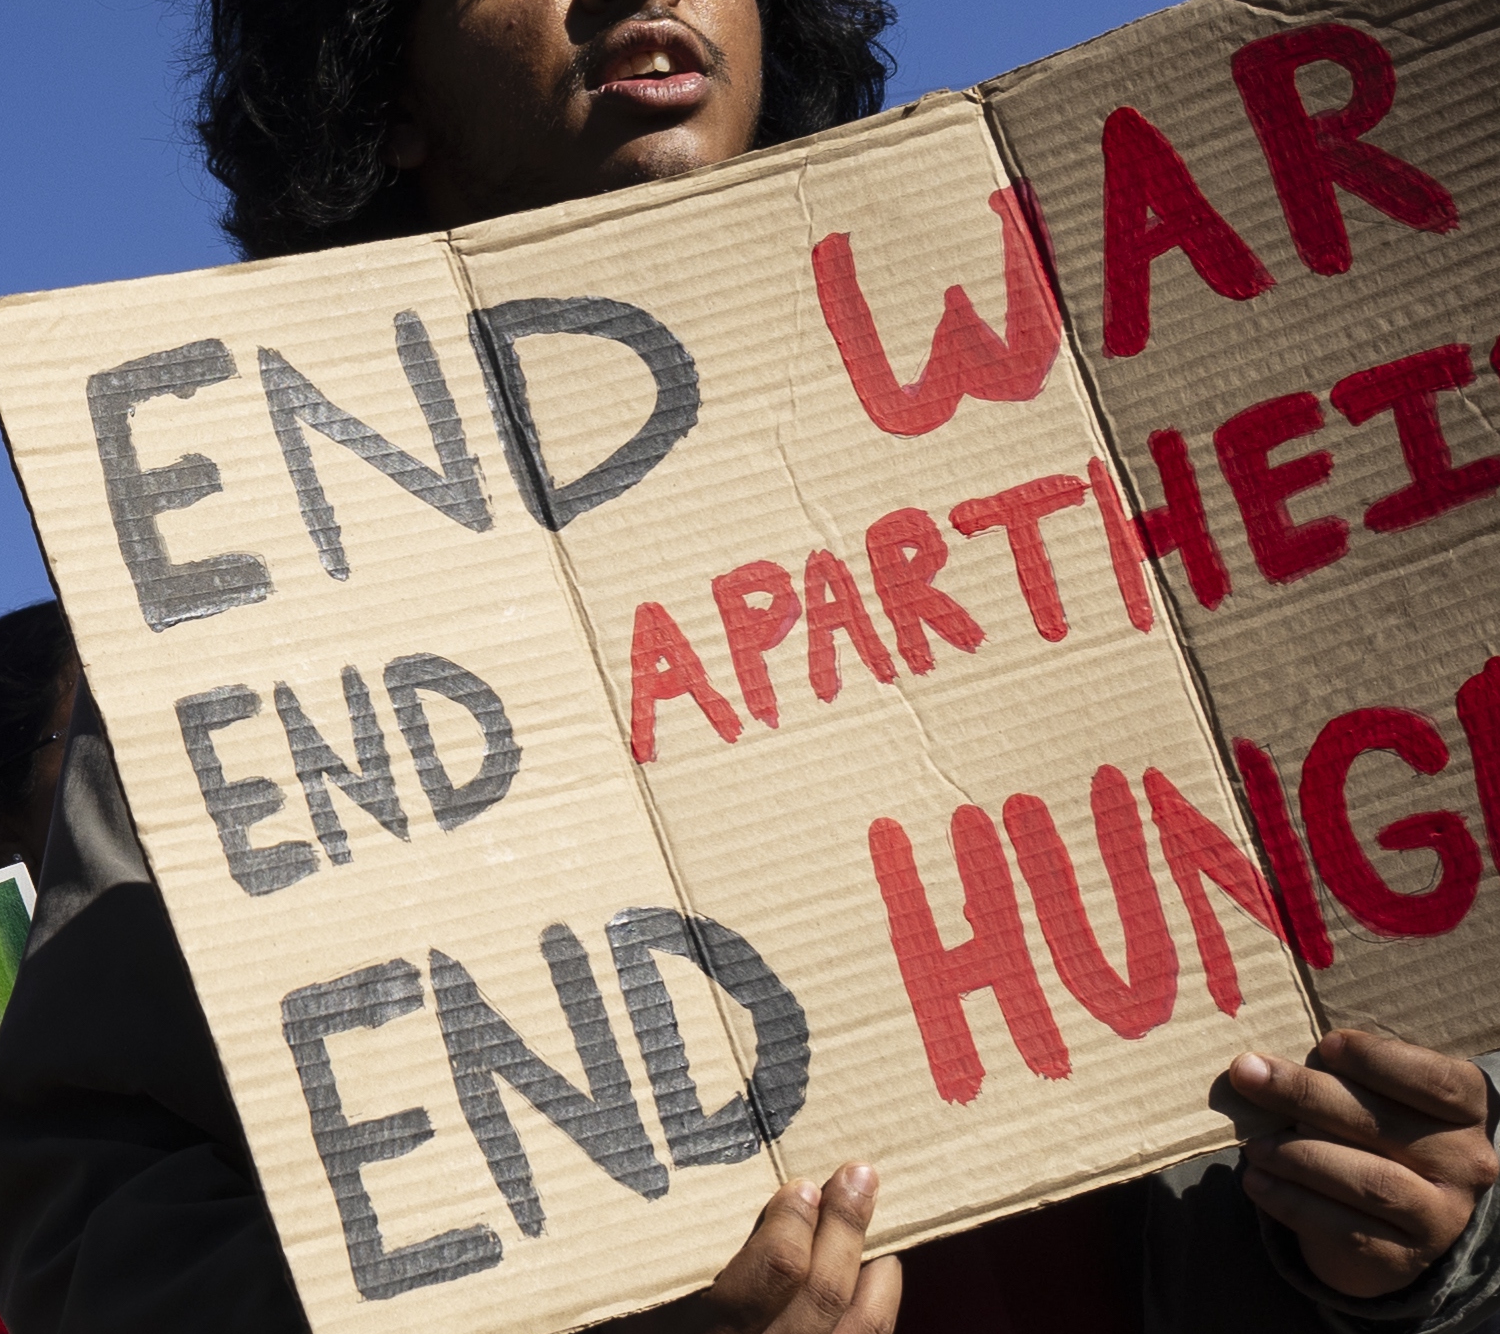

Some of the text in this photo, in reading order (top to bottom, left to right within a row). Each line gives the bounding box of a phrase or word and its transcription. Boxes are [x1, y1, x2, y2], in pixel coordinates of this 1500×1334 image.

[86, 21, 1460, 631] END WAR
[172, 652, 523, 897] END
[280, 905, 810, 1301] END
